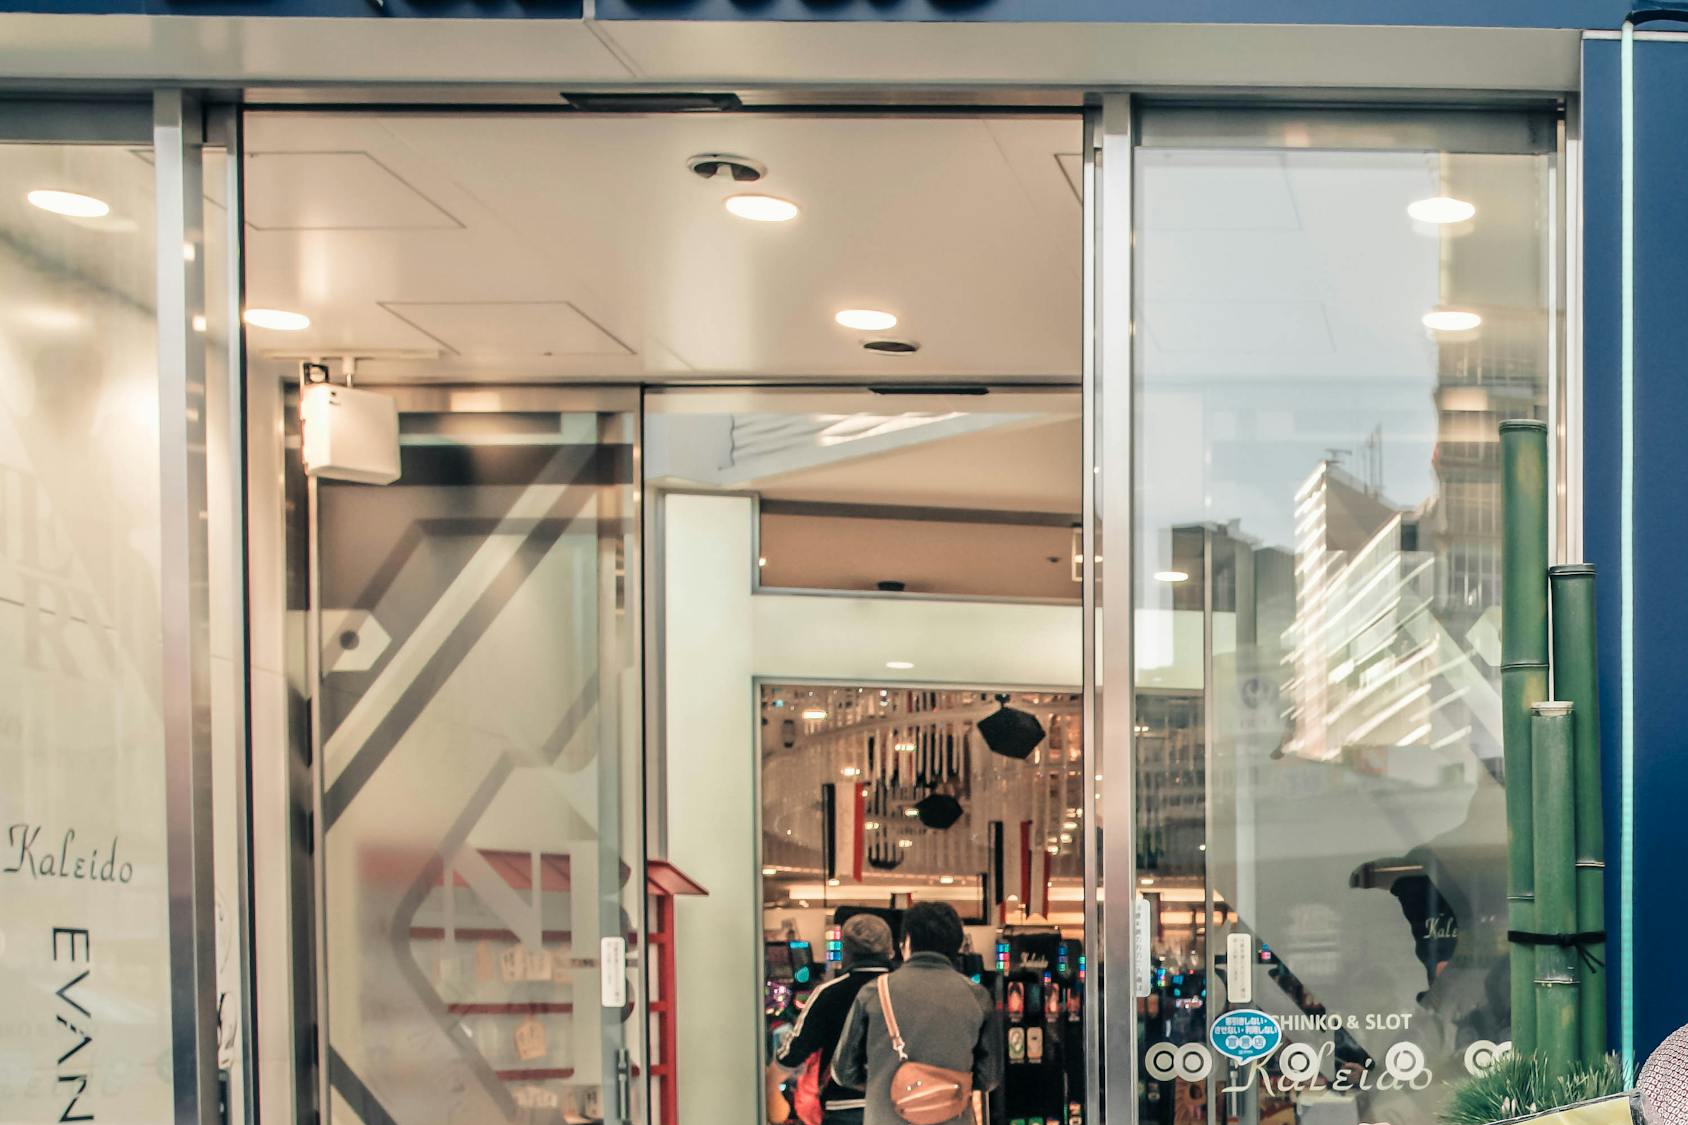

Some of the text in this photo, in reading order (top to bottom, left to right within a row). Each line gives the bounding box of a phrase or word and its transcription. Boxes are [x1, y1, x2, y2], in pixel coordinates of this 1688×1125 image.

[3, 823, 134, 884] Kaleido
[1346, 1014, 1360, 1030] &
[1365, 1013, 1413, 1031] SLOT
